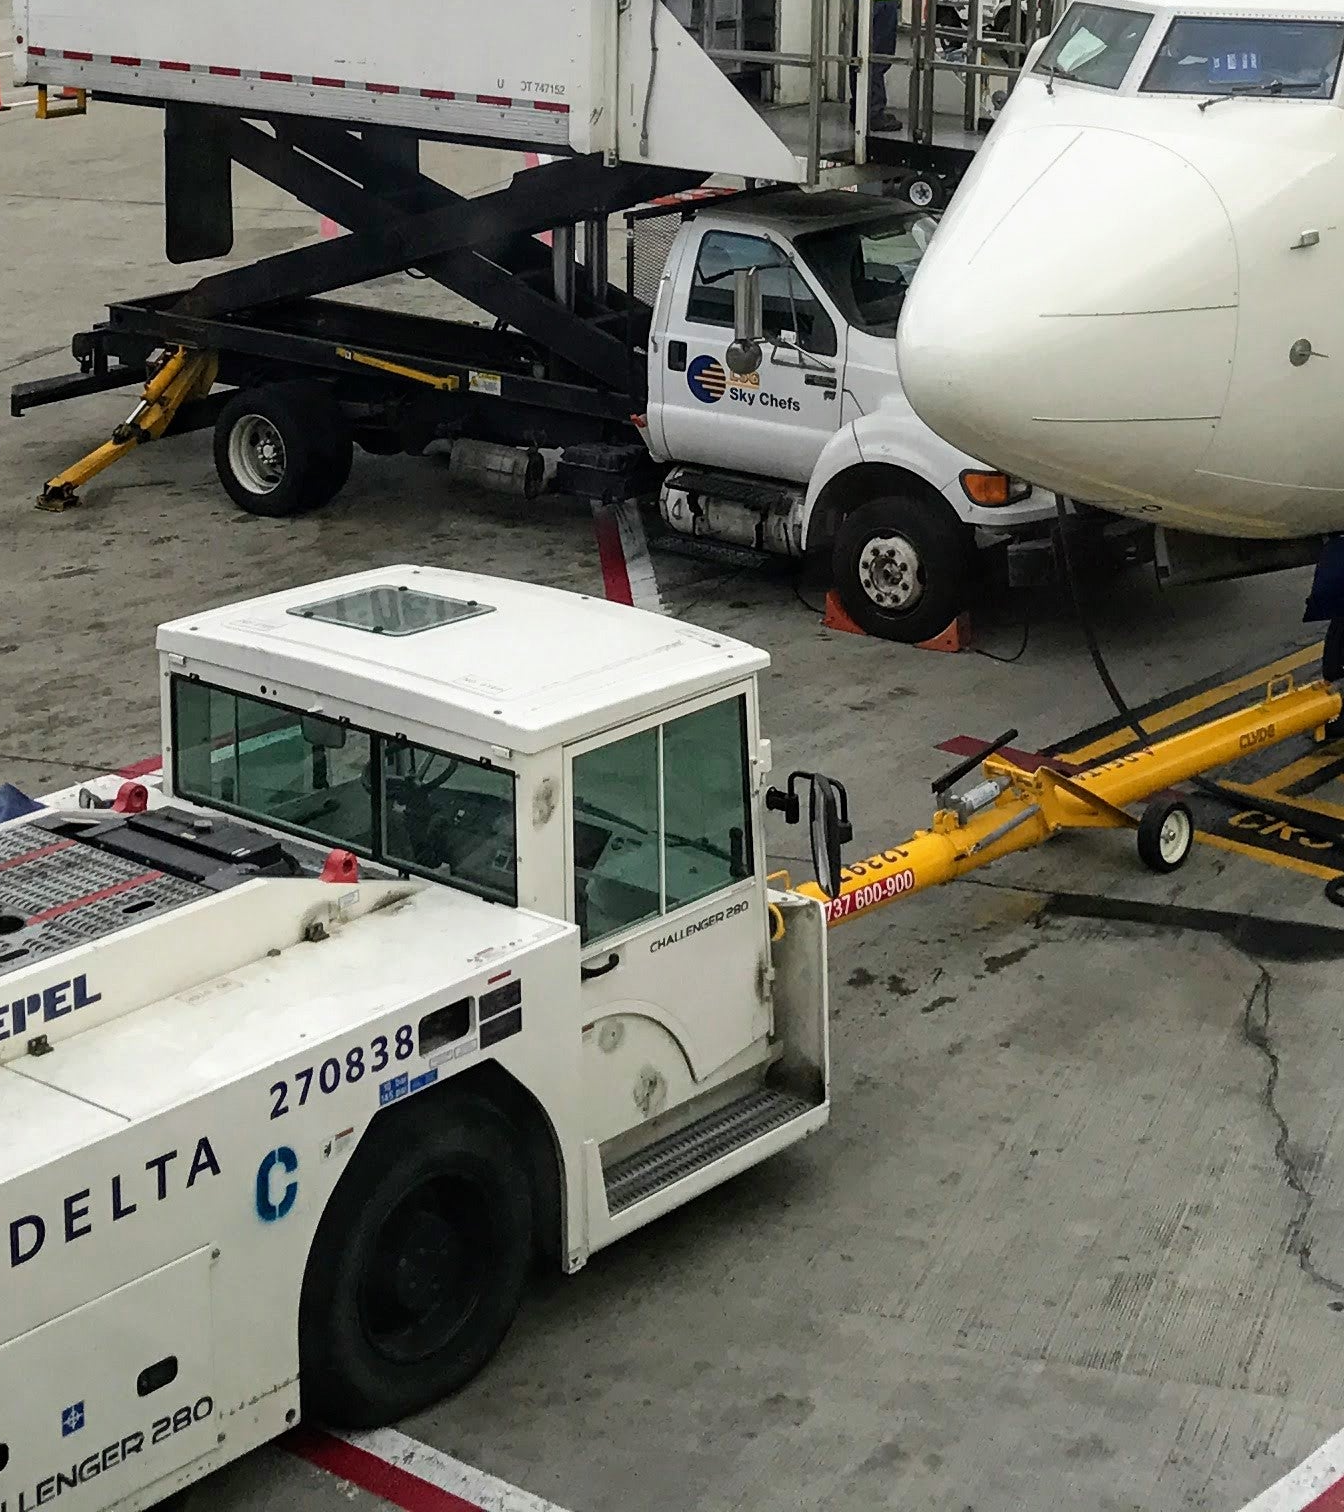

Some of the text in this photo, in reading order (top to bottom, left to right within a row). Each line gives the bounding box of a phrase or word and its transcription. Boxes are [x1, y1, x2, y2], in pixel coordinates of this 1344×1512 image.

[730, 388, 800, 411] Sky Chefs
[823, 869, 914, 922] 737 600-900
[648, 900, 750, 954] CHALLENGER 280
[269, 1023, 414, 1121] 270838
[9, 1135, 222, 1268] DELTA
[256, 1147, 298, 1221] C
[150, 1395, 214, 1446] 280
